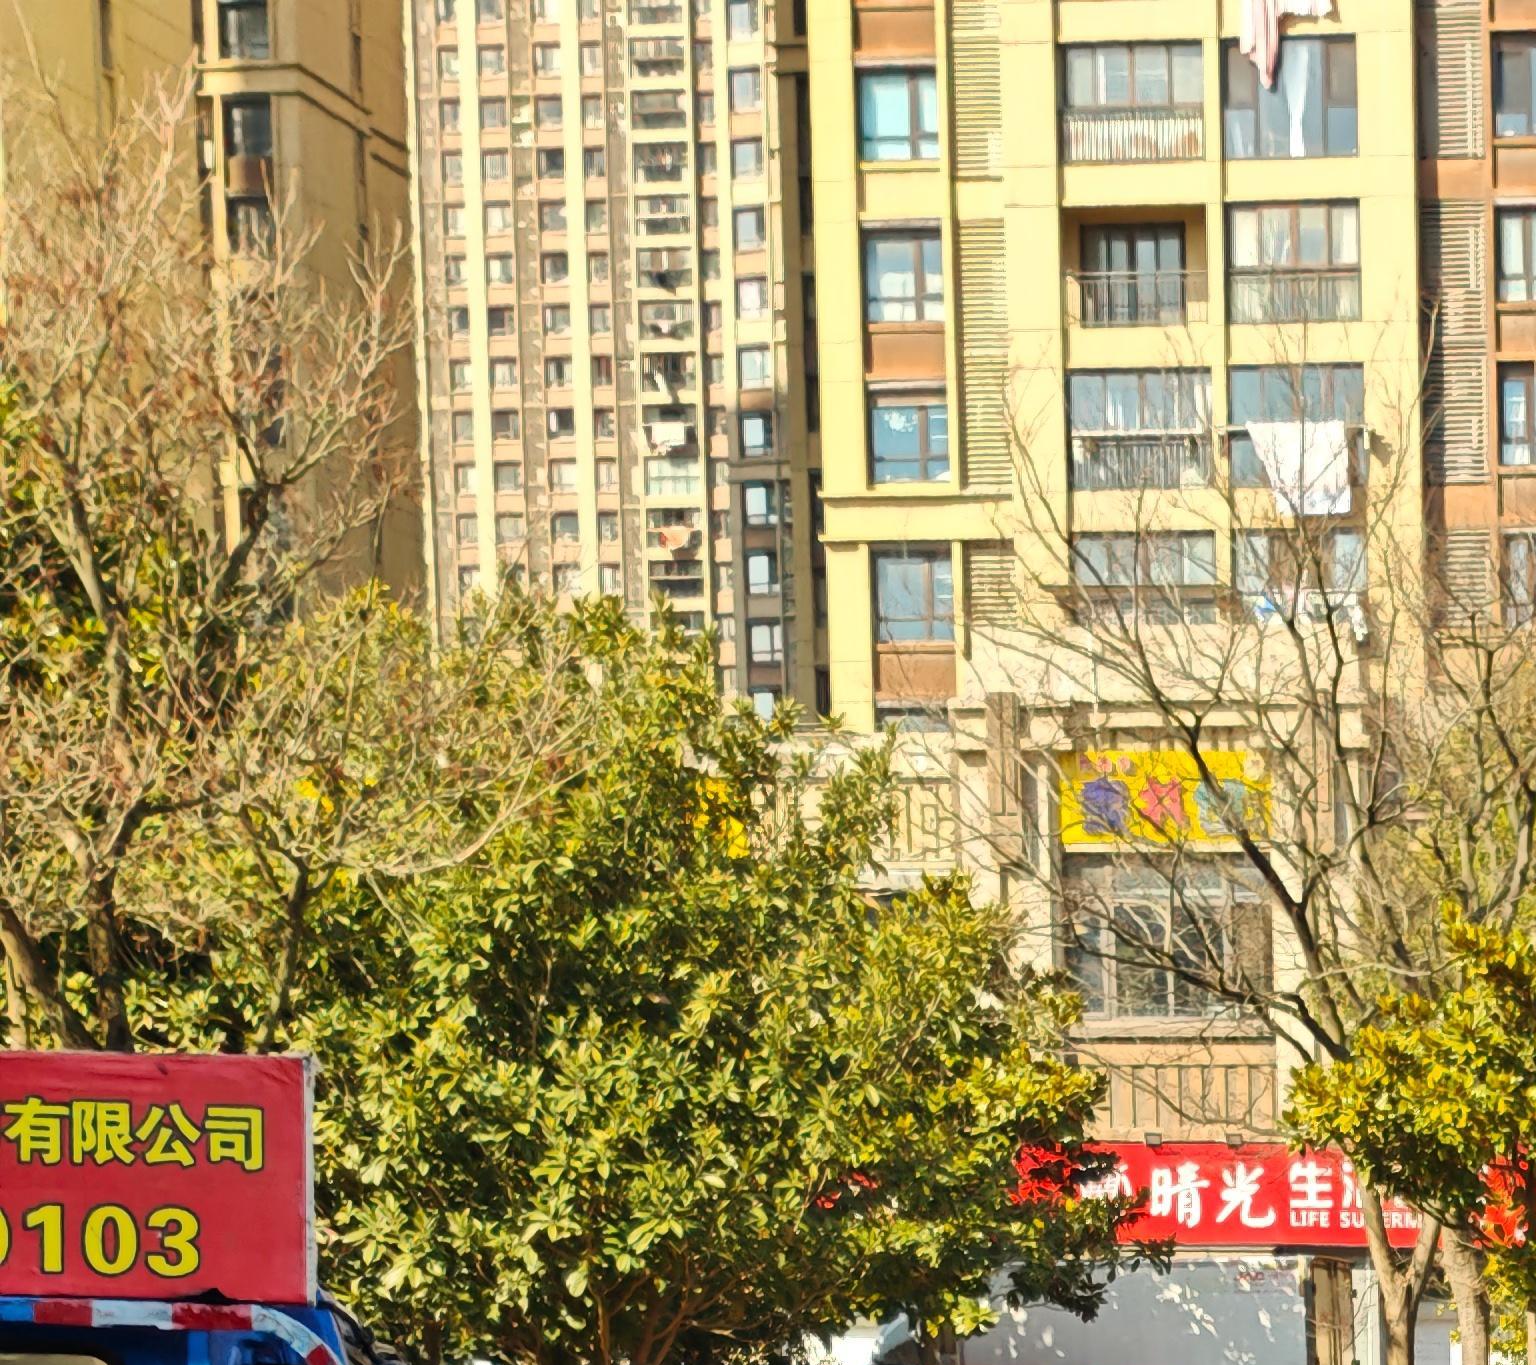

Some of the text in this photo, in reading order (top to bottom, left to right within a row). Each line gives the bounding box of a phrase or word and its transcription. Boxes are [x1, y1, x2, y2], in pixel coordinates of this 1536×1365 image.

[2, 1096, 265, 1172] 有限公司
[0, 1203, 201, 1278] 103
[1289, 1210, 1423, 1229] LIFE SUERM
